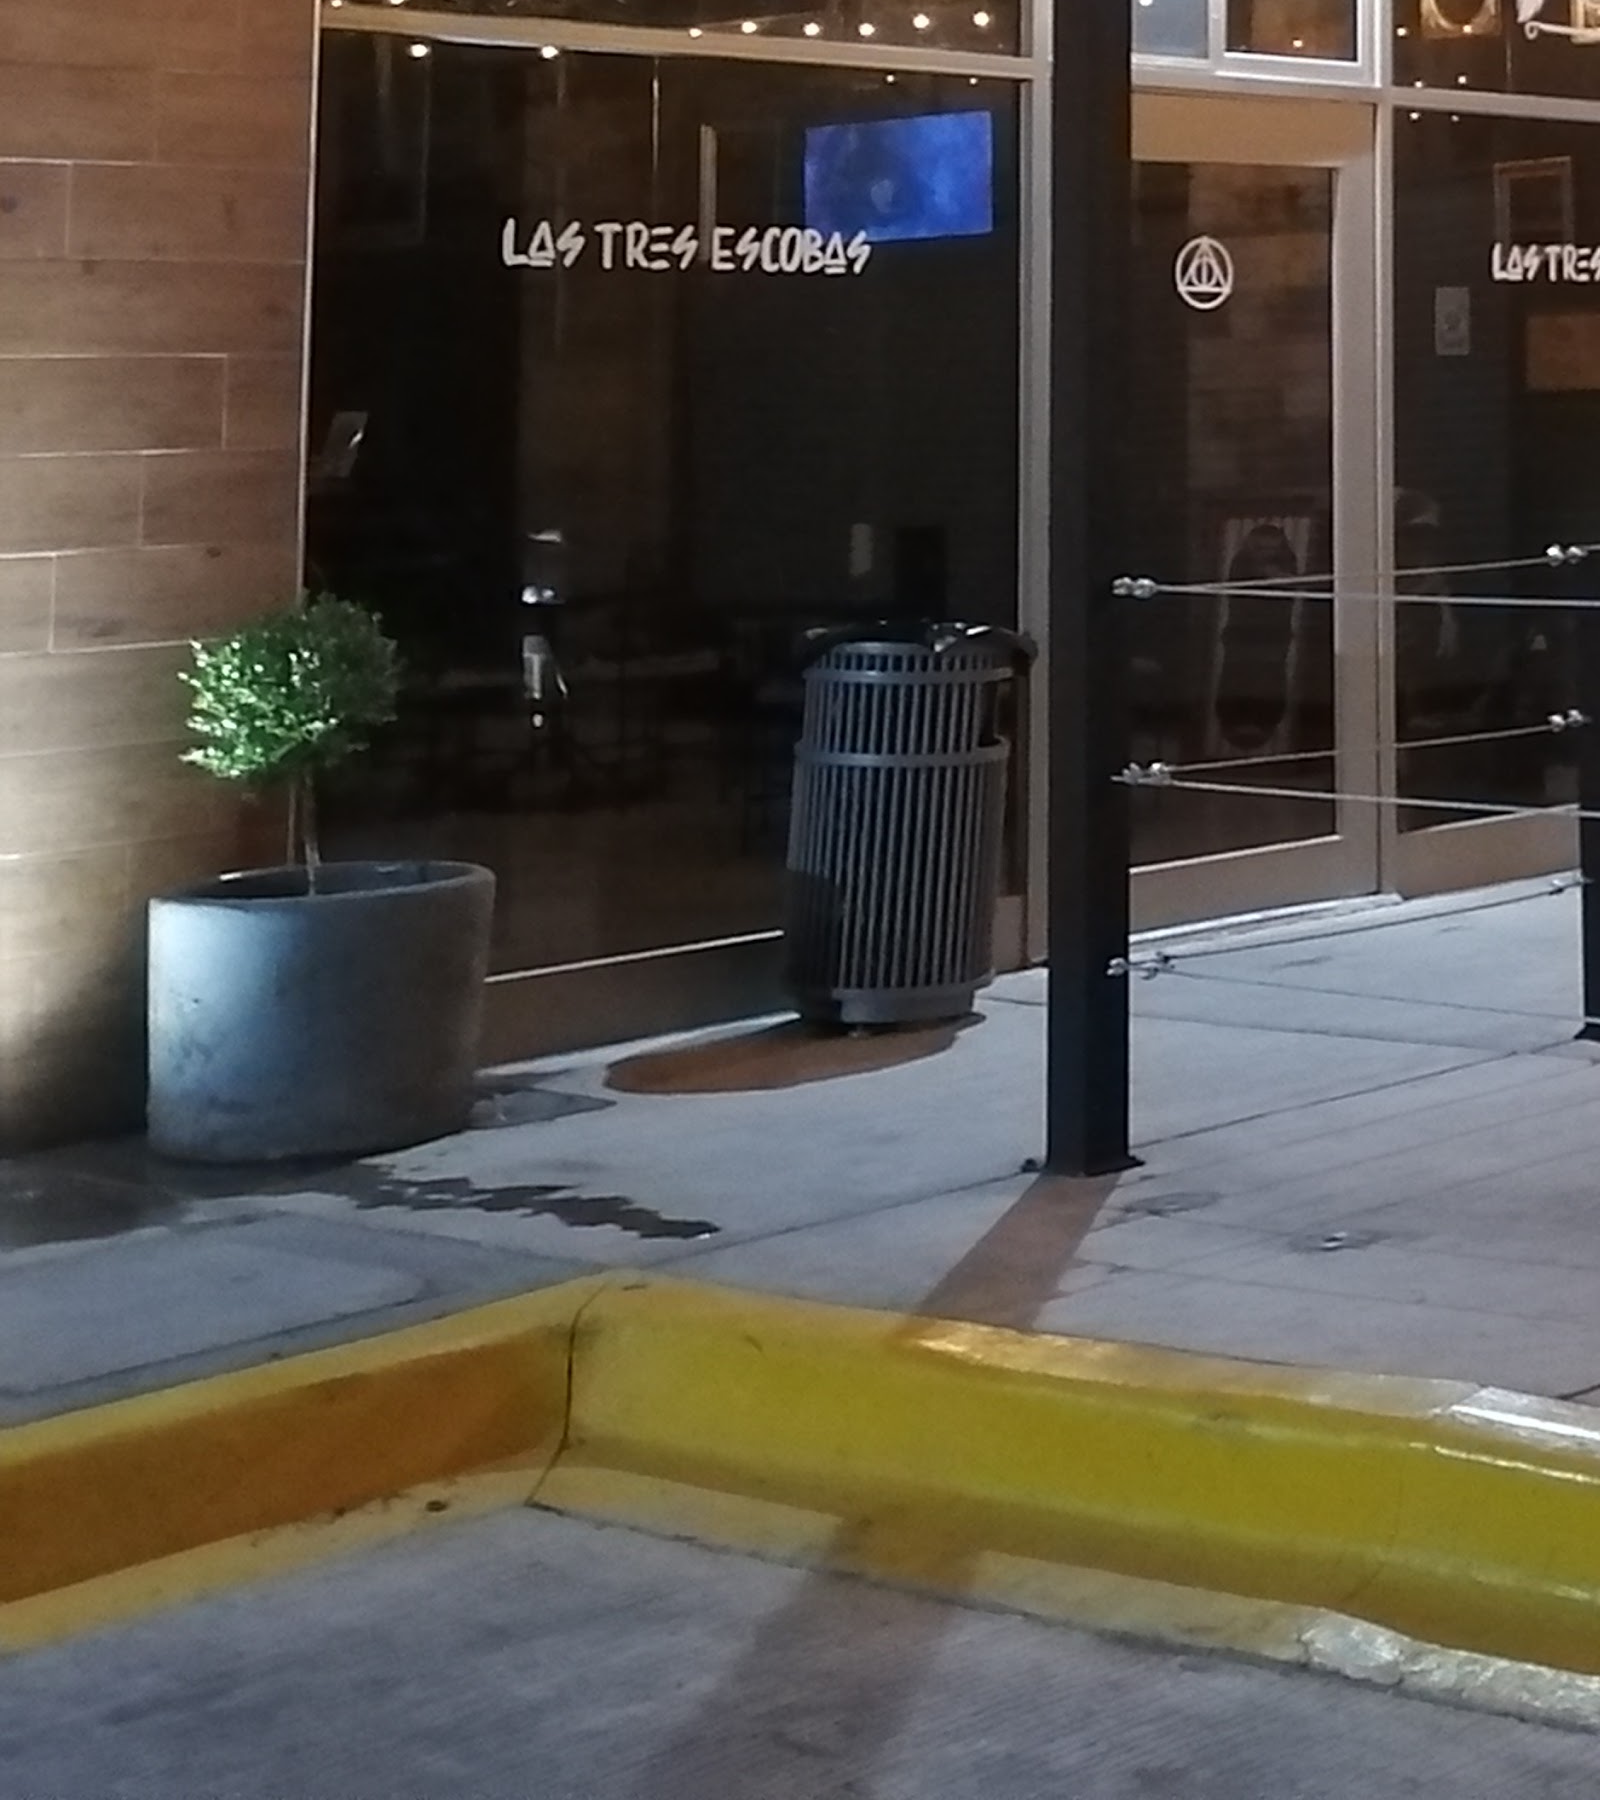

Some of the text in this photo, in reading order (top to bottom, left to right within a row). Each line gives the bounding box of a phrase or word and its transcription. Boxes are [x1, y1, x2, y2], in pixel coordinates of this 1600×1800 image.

[502, 218, 872, 275] LAS TRES ESCOBAS
[1491, 243, 1541, 281] LAS
